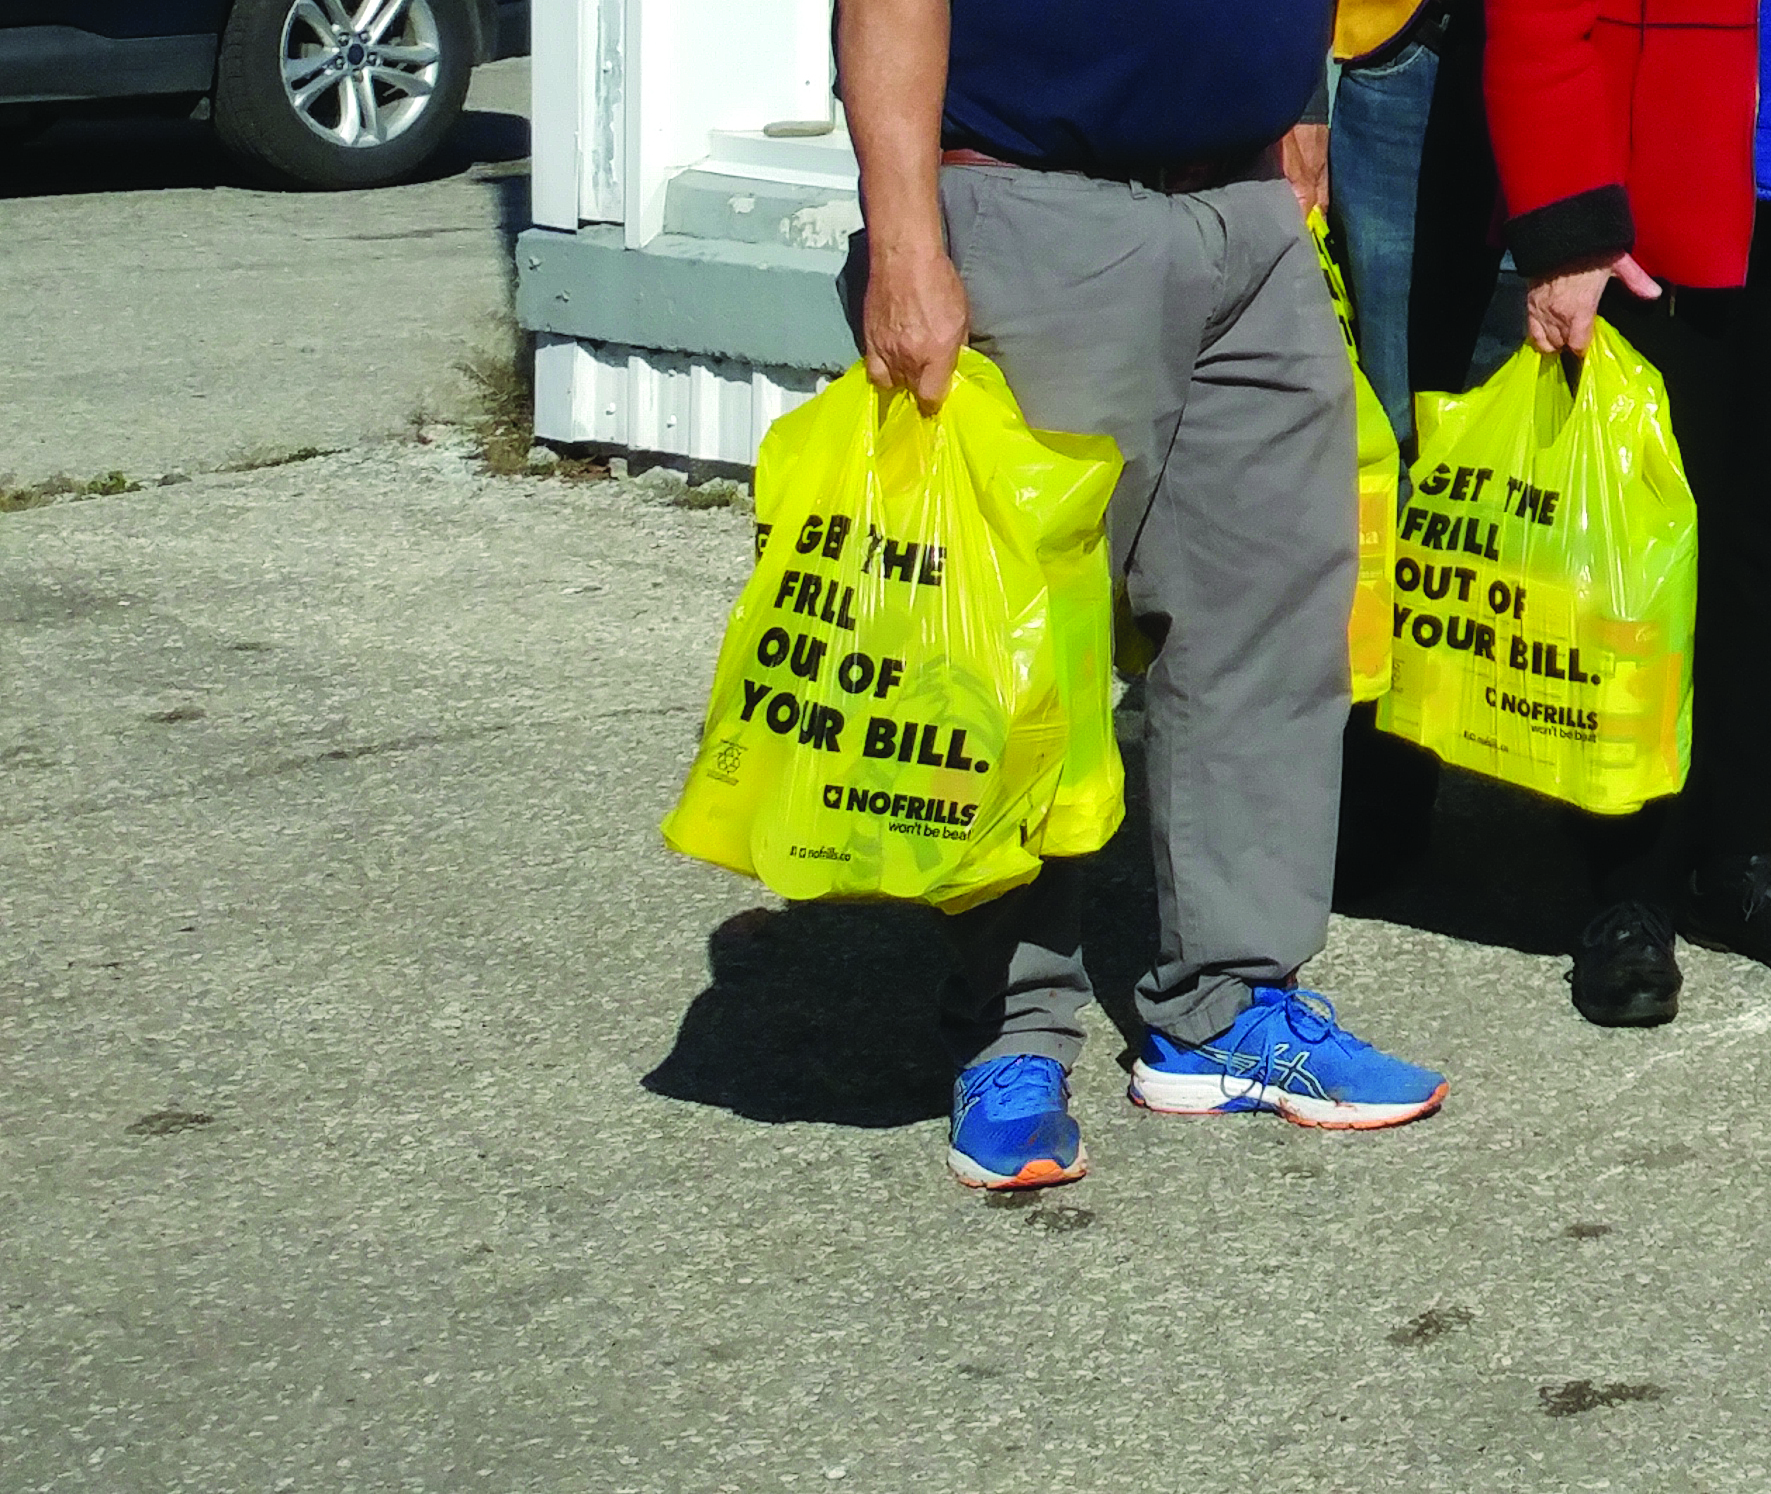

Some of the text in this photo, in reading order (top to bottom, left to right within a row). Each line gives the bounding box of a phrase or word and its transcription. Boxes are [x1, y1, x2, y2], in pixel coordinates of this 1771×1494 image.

[1418, 462, 1560, 526] GET THE
[1400, 506, 1499, 562] FRILL
[1395, 556, 1526, 620] OUT OF
[757, 627, 906, 698] OUT OF
[1392, 602, 1601, 686] YOUR BILL.
[739, 679, 990, 773] YOUR BILL.
[1501, 692, 1598, 730] NOFRILLS
[1531, 724, 1557, 737] won't
[1559, 727, 1573, 740] be
[846, 787, 979, 826] NOFRILLS
[888, 820, 921, 836] won't
[923, 823, 941, 839] be
